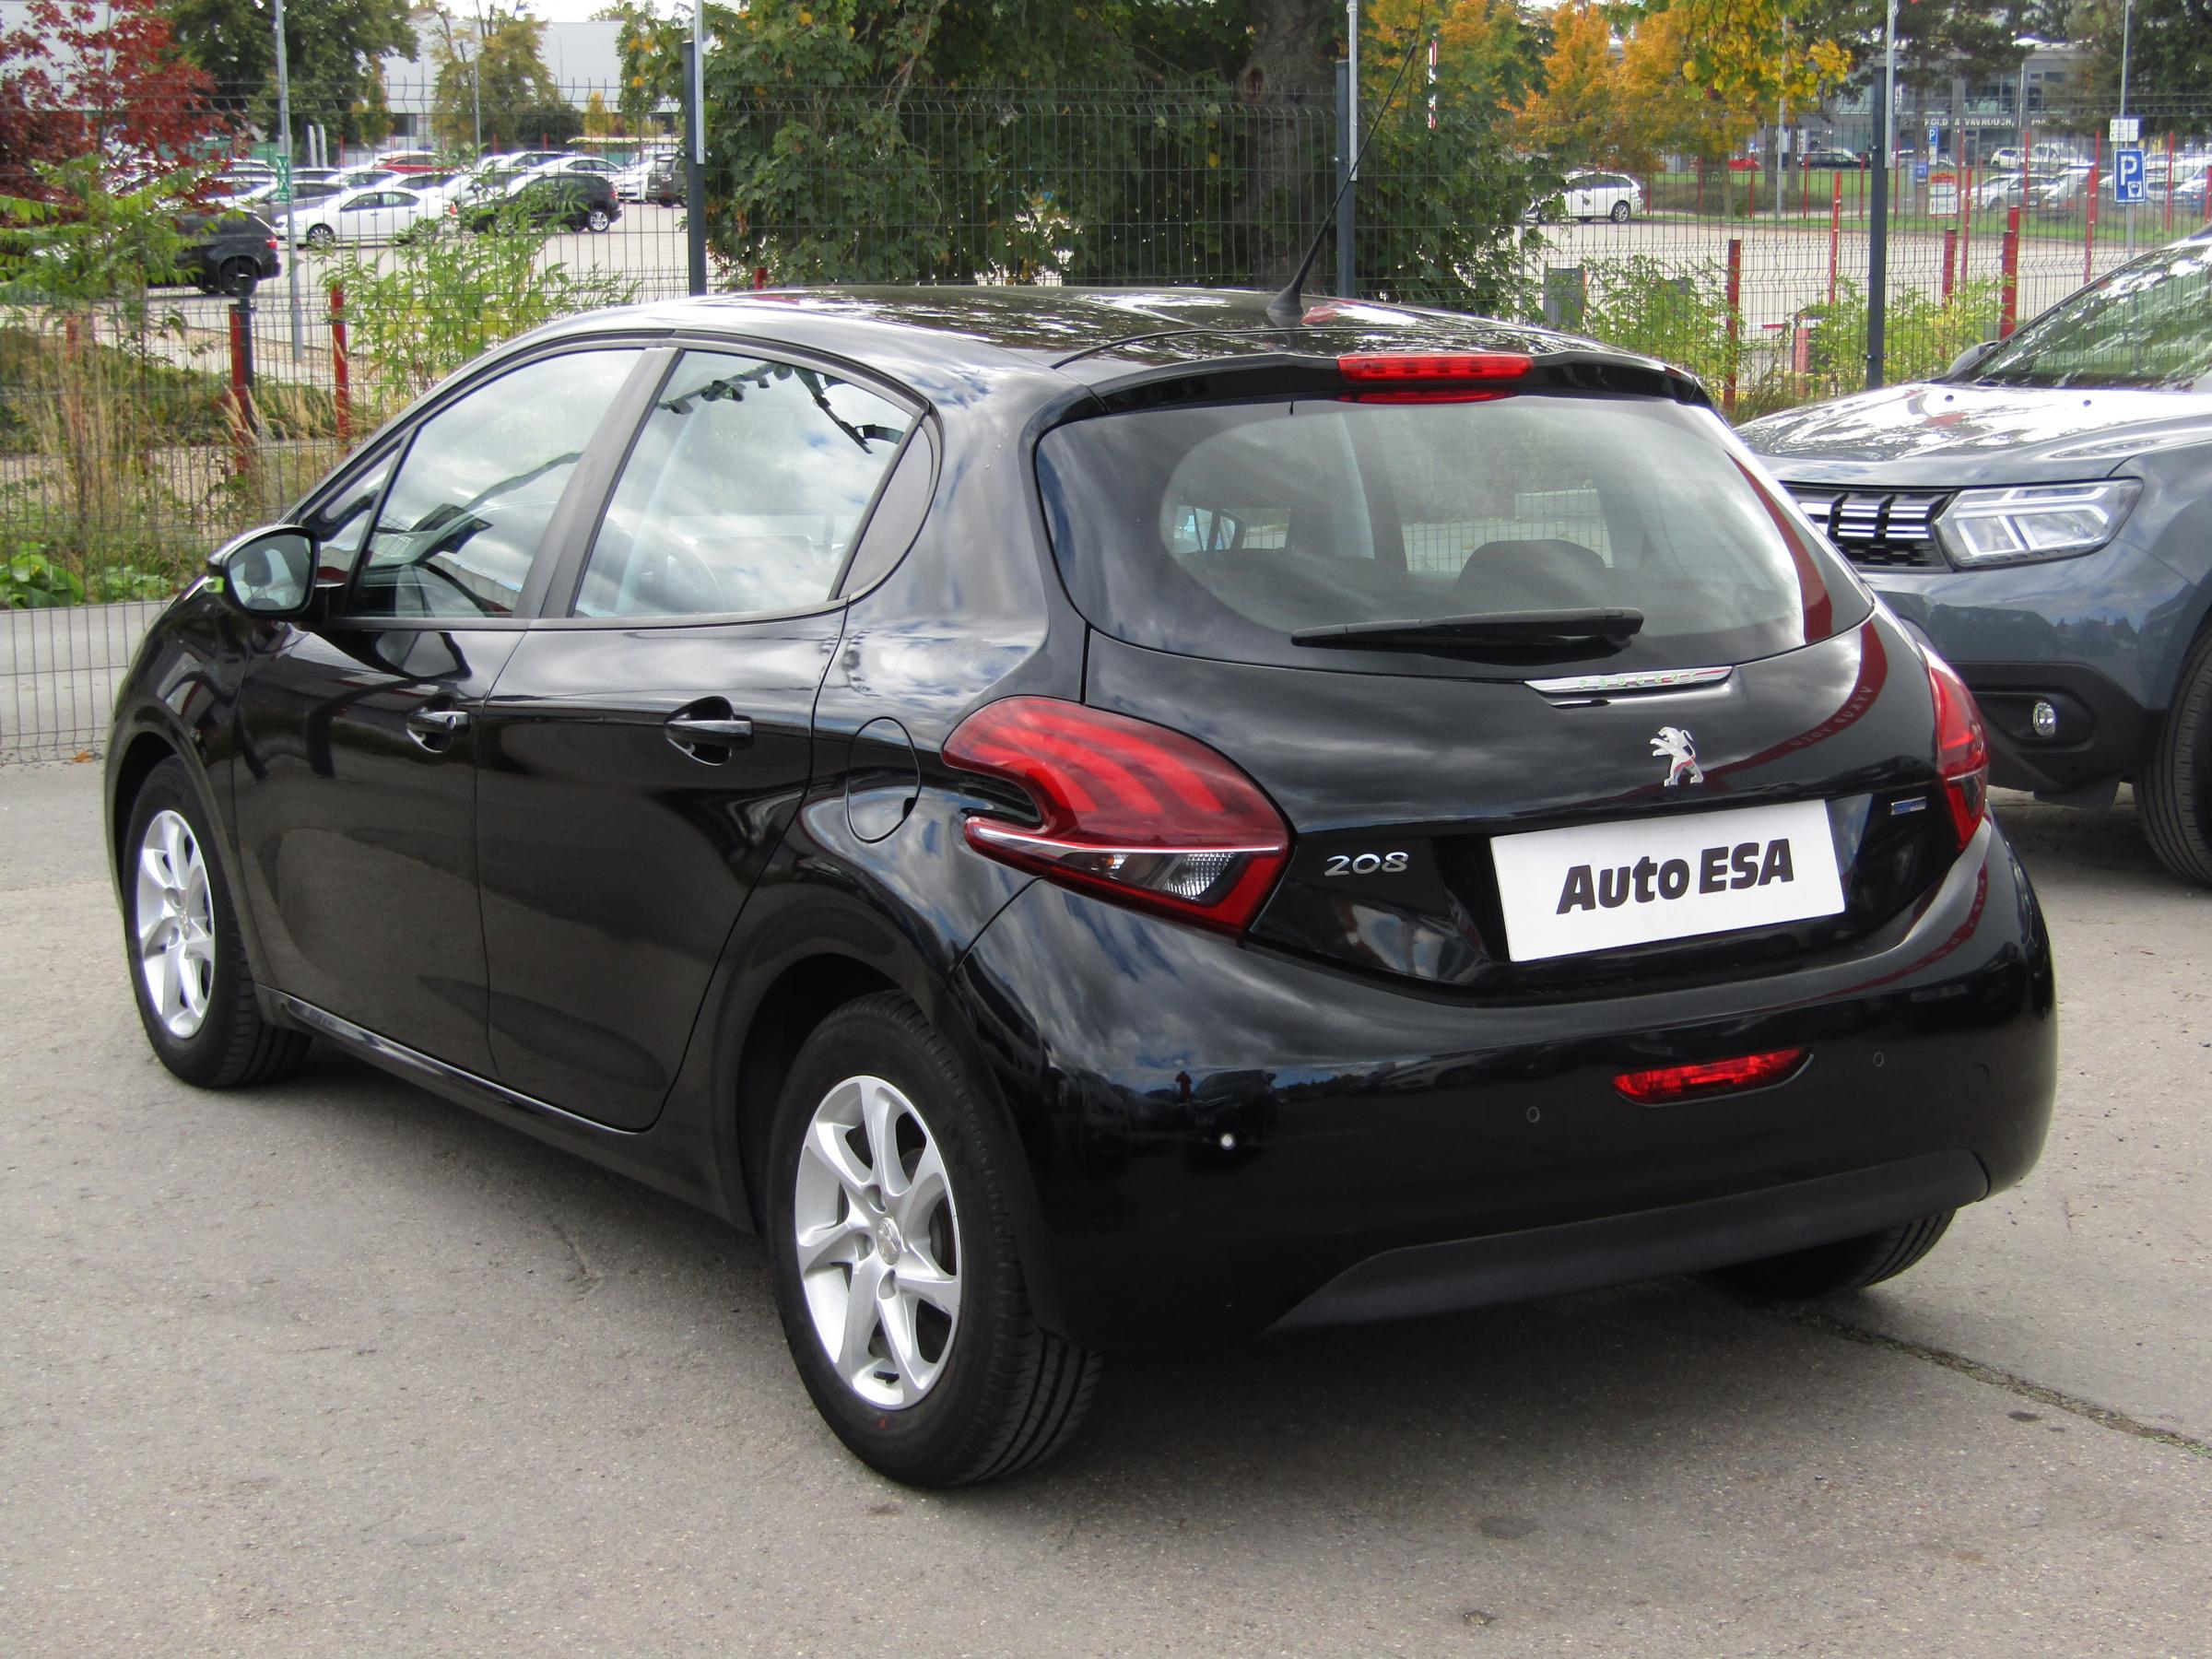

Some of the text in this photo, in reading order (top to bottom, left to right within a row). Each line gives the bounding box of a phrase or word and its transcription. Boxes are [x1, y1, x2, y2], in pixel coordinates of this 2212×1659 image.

[1929, 129, 1936, 141] P
[2120, 155, 2137, 186] P
[1324, 851, 1409, 877] 208
[1556, 838, 1794, 915] Auto ESA
